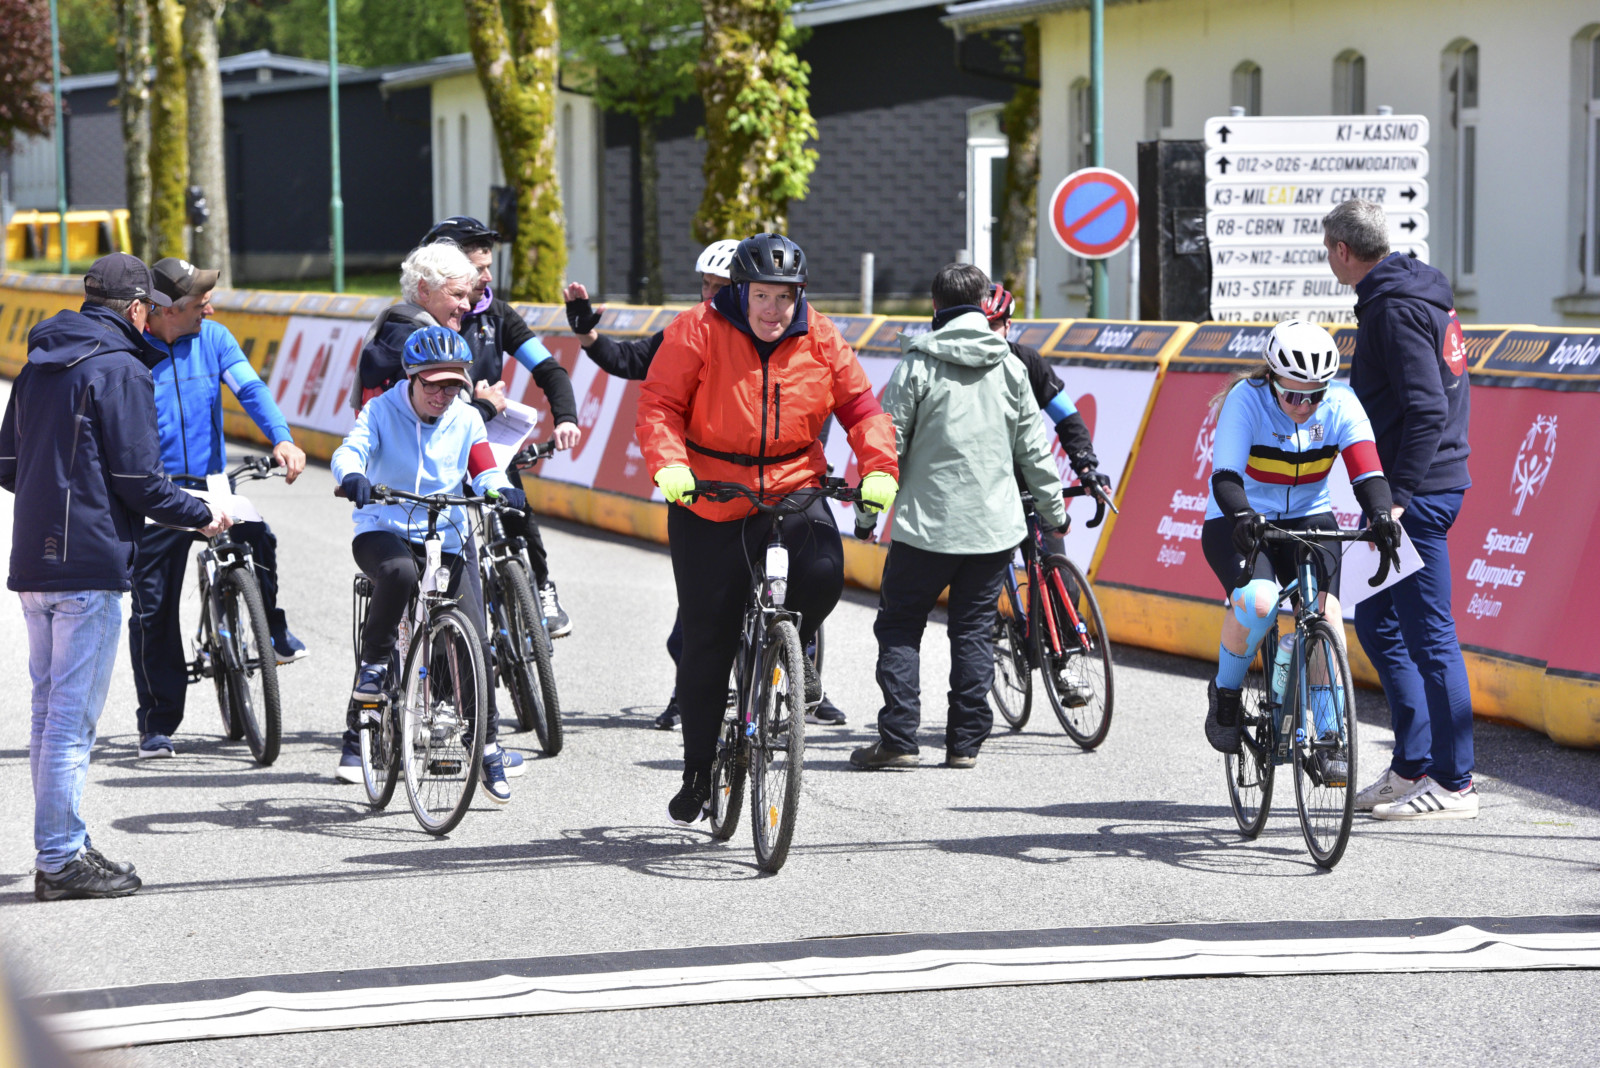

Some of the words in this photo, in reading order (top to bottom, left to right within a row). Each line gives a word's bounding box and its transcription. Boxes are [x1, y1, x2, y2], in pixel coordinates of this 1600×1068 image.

[1330, 188, 1386, 204] CENTER
[1293, 218, 1325, 234] TRAI
[1169, 489, 1209, 513] Special
[1156, 515, 1203, 542] Olympics
[1483, 527, 1533, 555] Special
[1466, 558, 1526, 589] Olympics
[1466, 593, 1503, 620] Belgium
